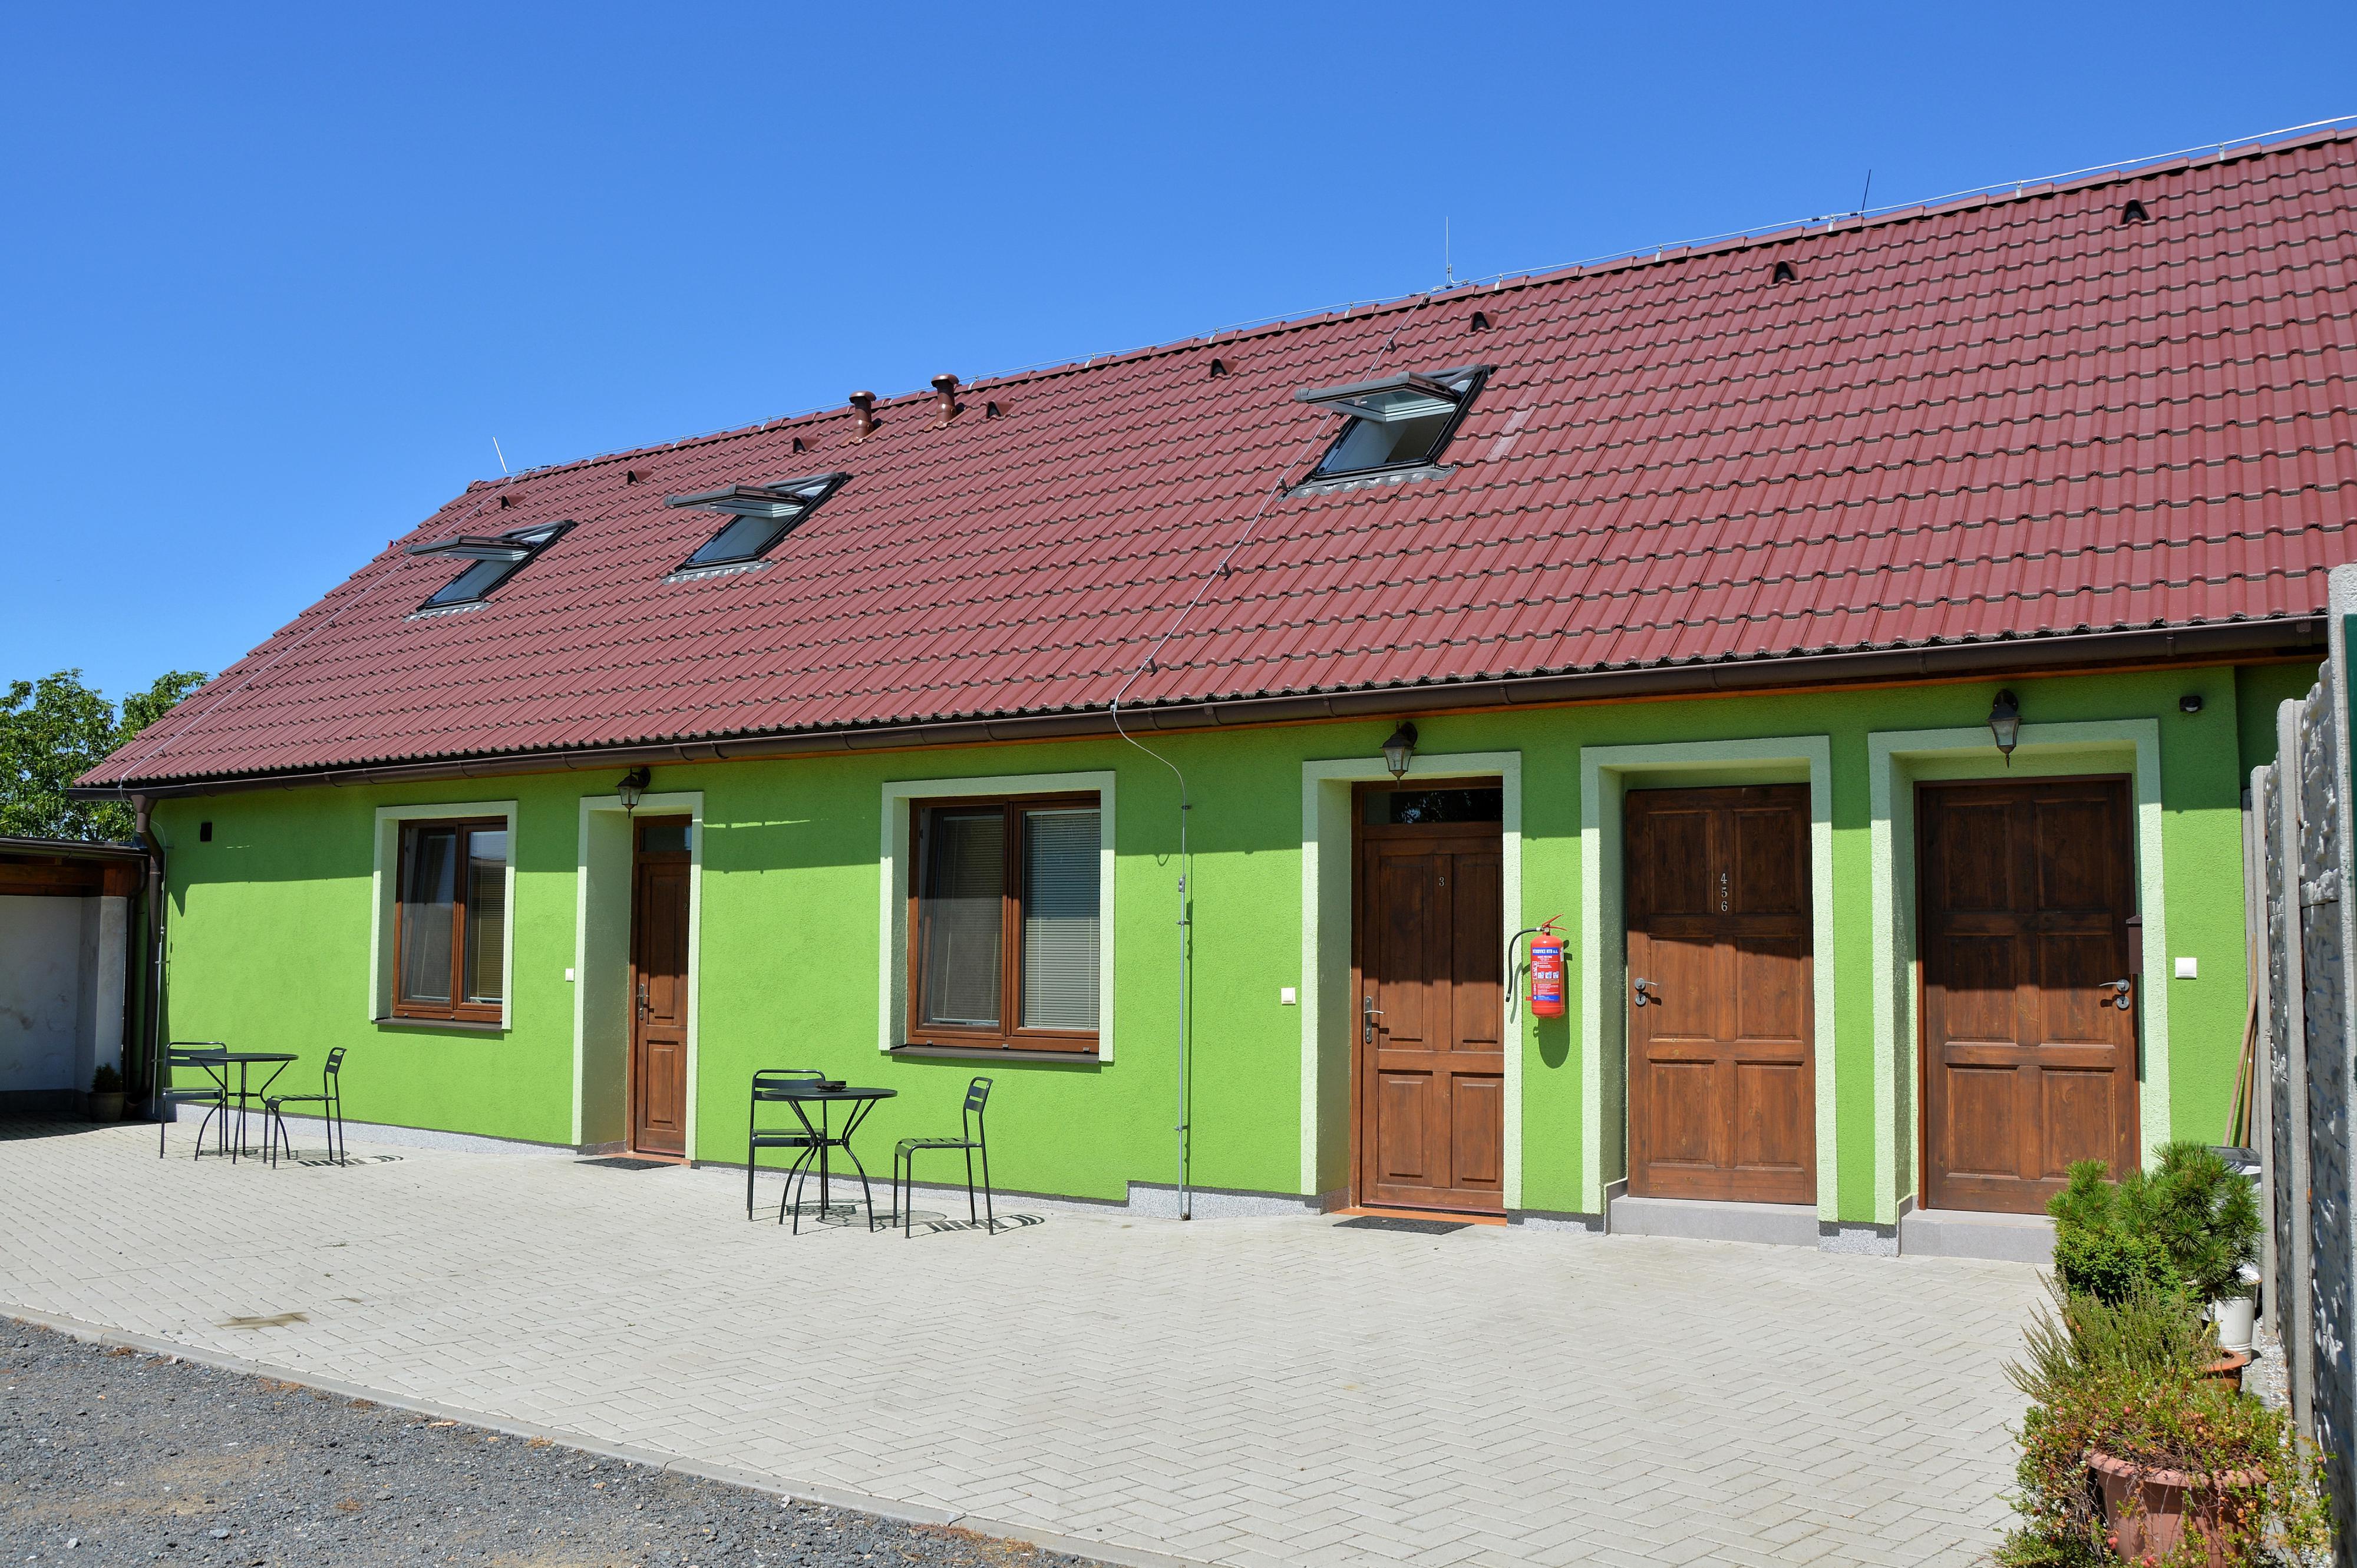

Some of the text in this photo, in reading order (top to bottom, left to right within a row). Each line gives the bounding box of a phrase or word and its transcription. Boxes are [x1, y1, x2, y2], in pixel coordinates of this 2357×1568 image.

[1439, 876, 1445, 887] 3
[1721, 873, 1728, 884] 4
[1721, 887, 1728, 898] 5
[1721, 900, 1728, 912] 6
